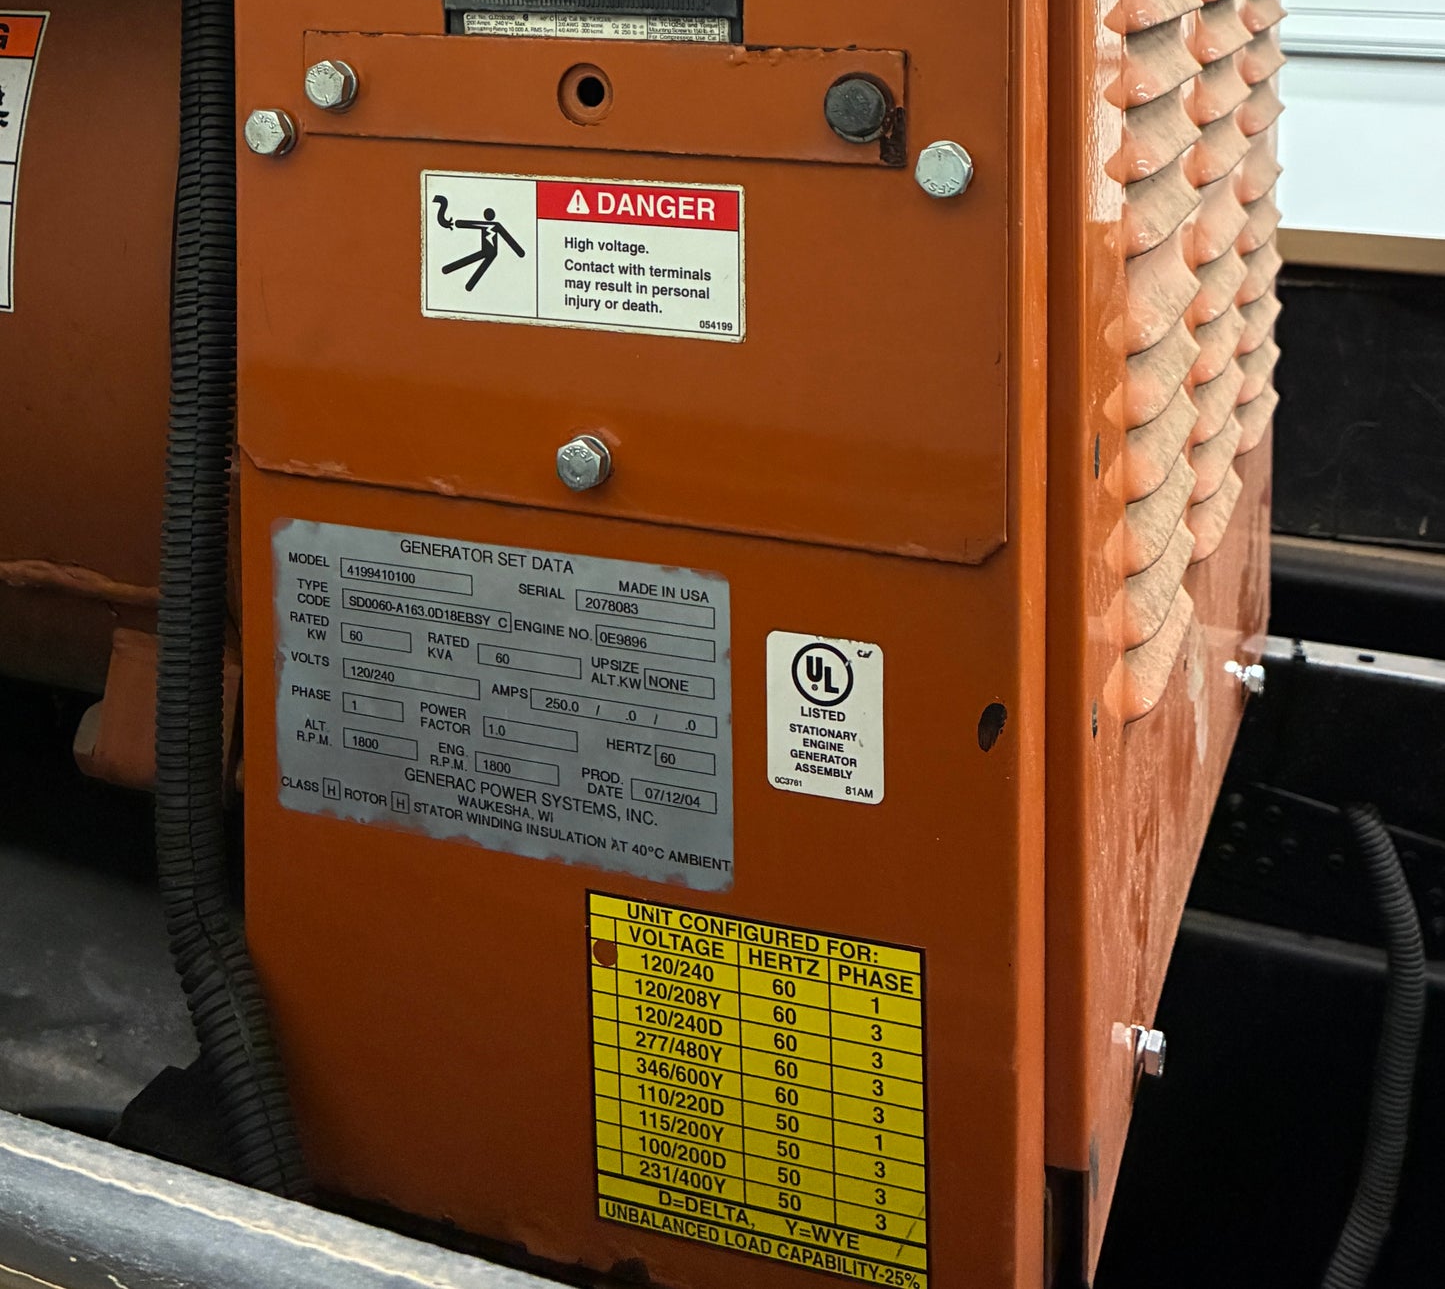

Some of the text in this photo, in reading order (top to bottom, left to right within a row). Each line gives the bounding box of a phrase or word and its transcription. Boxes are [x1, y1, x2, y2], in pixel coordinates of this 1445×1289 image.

[598, 191, 715, 221] DANGER
[564, 236, 650, 256] High voltage.
[564, 259, 712, 281] Contact with terminals
[564, 280, 710, 302] may result in personal
[564, 294, 662, 314] injury or death.
[699, 320, 733, 332] 054199
[288, 551, 416, 585] MODEL 4199410100
[400, 539, 574, 575] GENERATOR SET DATA
[297, 578, 329, 593] TYPE
[618, 580, 710, 603] MADE IN USA
[297, 593, 331, 608] CODE
[498, 616, 508, 628] C
[518, 583, 639, 615] SERIAL 2078083
[290, 611, 330, 627] RATED
[514, 619, 565, 637] ENGINE
[568, 626, 593, 641] NO.
[307, 628, 363, 642] KW 60
[428, 632, 470, 649] RATED
[291, 651, 395, 682] VOLTS 120/240
[428, 647, 510, 665] KVA 60
[591, 656, 640, 674] UPSIZE
[591, 672, 689, 692] ALT.KW NONE
[806, 655, 839, 694] UL
[291, 685, 357, 711] PHASE 1
[491, 684, 696, 731] AMPS 250.0 / .0 / .0
[420, 701, 467, 720] POWER
[800, 706, 846, 722] LISTED
[304, 718, 330, 733] ALT.
[420, 716, 506, 737] FACTOR 1.0
[789, 723, 857, 742] STATIONARY
[296, 731, 379, 750] R.P.M. 1800
[438, 742, 469, 758] ENG.
[606, 738, 676, 765] HERTZ 60
[803, 738, 844, 753] ENGINE
[430, 755, 511, 774] R.P.M. 1800
[790, 749, 857, 767] GENERATOR
[581, 767, 624, 785] PROD.
[795, 762, 853, 780] ASSEMBLY
[404, 767, 658, 827] GENERAC POWER SYSTEMS, INC.
[587, 782, 701, 808] DATE 07/12/04
[845, 786, 874, 798] 81AM
[457, 794, 554, 823] WAUKESHA, WI
[281, 776, 731, 872] CLASS H ROTOR H STATOR WINDING INSULATION AT 40°C AMBIENT
[626, 903, 878, 964] UNIT CONFIGURED FOR:
[629, 926, 914, 995] VOLTAGE HERTZ PHASE
[640, 953, 879, 1014] 120/240 60 1
[635, 978, 882, 1042] 120/208Y 60 3
[635, 1005, 883, 1070] 120/240D 60 3
[635, 1031, 884, 1097] 277/480Y 60 3
[636, 1057, 884, 1125] 346/600Y 60 3
[637, 1084, 883, 1152] 110/220D 50 1
[639, 1110, 886, 1180] 115/200Y 50 3
[639, 1136, 886, 1206] 100/200D 50 3
[639, 1161, 887, 1232] 231/400Y 50 3
[658, 1190, 860, 1251] D=DELTA, Y=WYE
[605, 1202, 920, 1289] UNBALANCED LOAD CAPABILITY-25%
